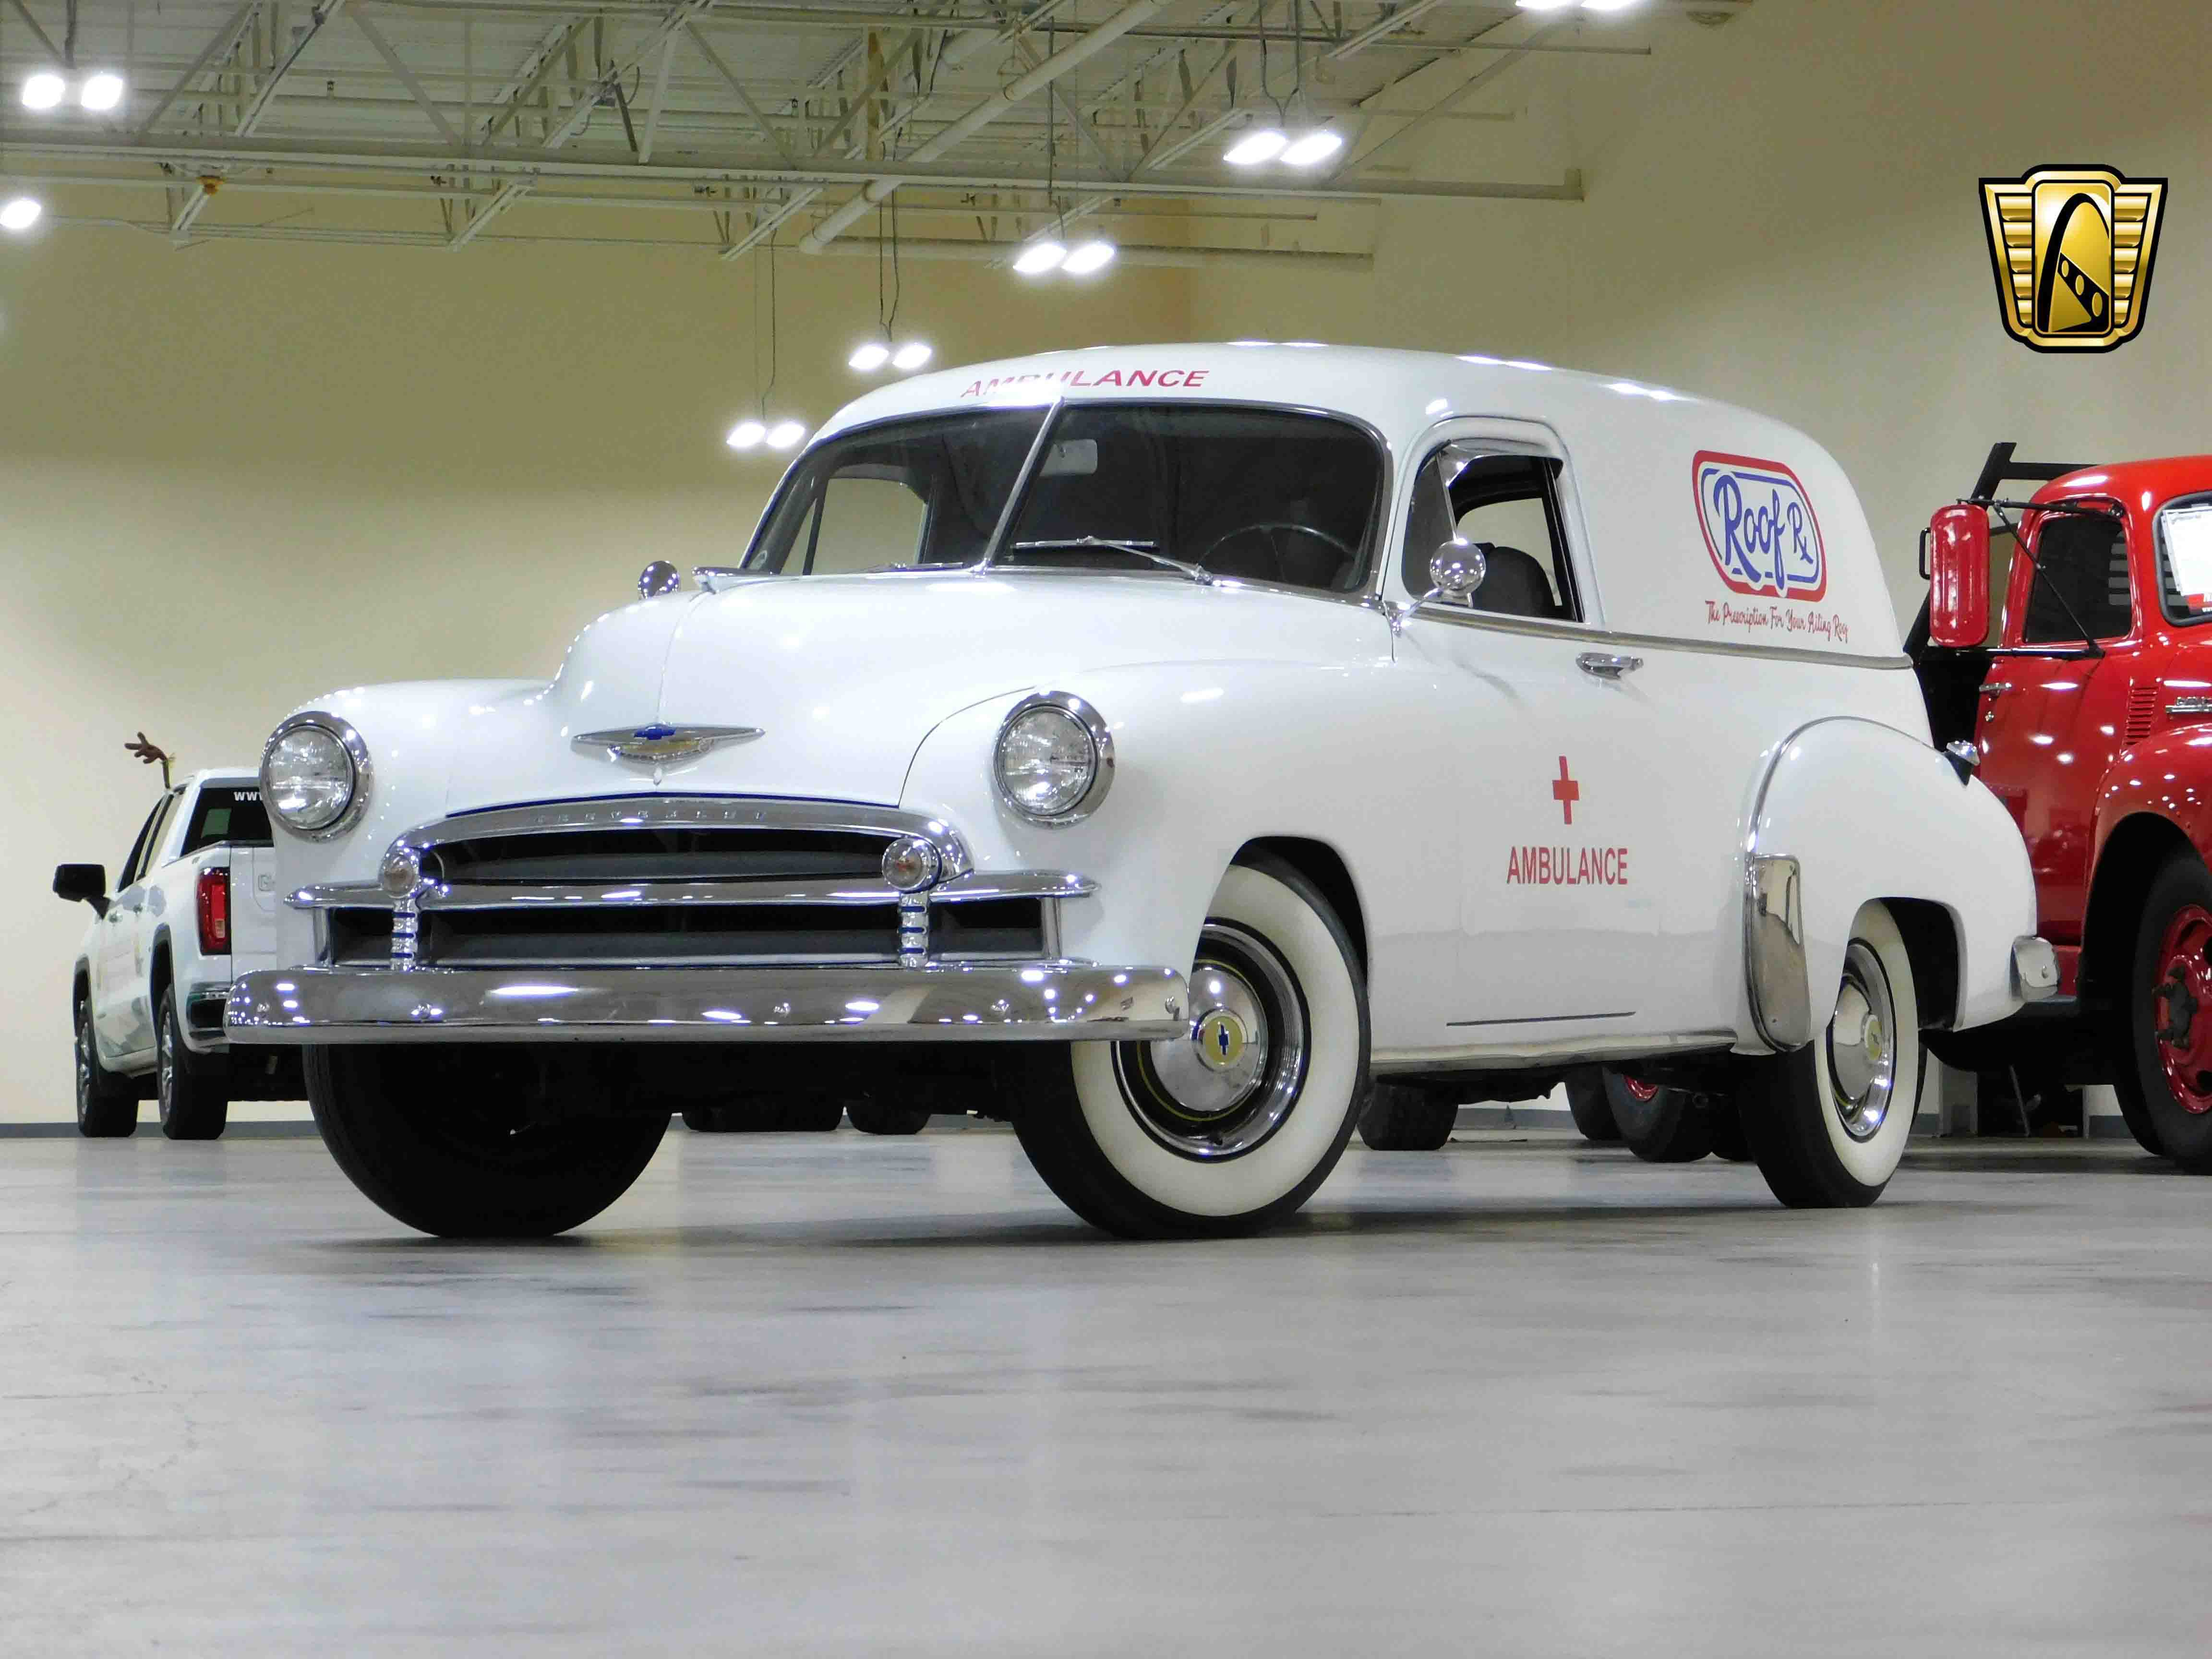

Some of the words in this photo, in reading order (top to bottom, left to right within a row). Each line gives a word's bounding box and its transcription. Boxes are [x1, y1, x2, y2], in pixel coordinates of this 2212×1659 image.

[960, 370, 1209, 398] AMLANCE
[1713, 474, 1786, 590] Roof
[1705, 600, 1719, 625] The
[1722, 602, 1768, 633] Prescription
[1769, 606, 1784, 630] For
[1785, 609, 1805, 632] Your
[1807, 611, 1831, 642] Ailing
[1506, 846, 1628, 885] AMBULANCE
